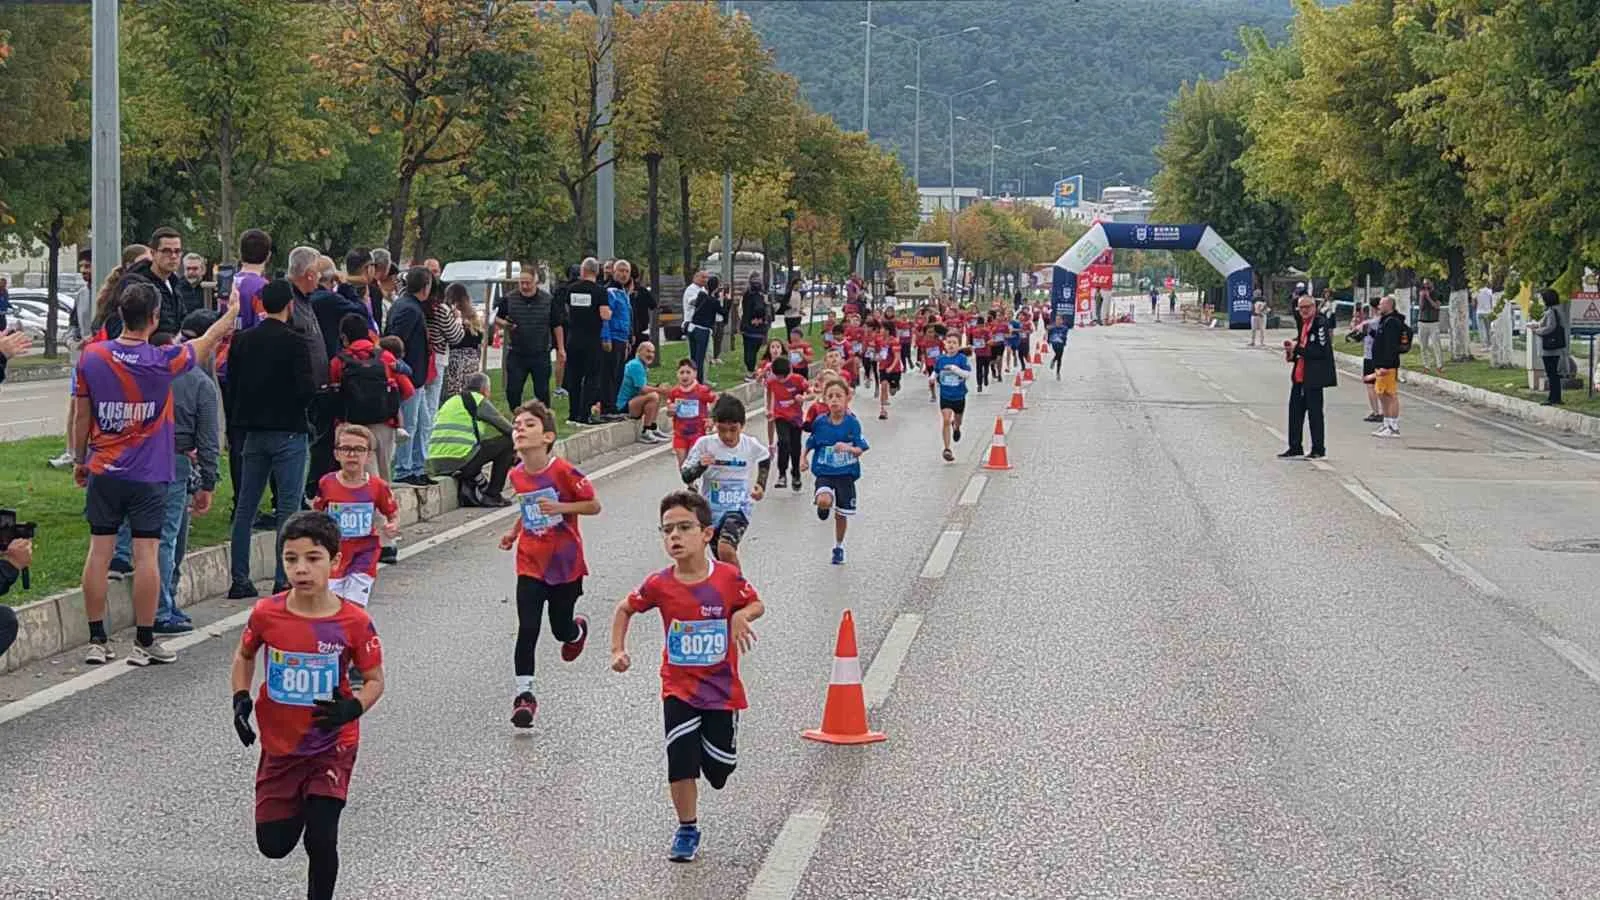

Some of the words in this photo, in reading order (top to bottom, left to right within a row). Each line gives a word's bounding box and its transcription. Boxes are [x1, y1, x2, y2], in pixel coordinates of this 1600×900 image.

[340, 512, 373, 529] 8013
[680, 633, 725, 655] 8029
[282, 668, 334, 693] 8011
